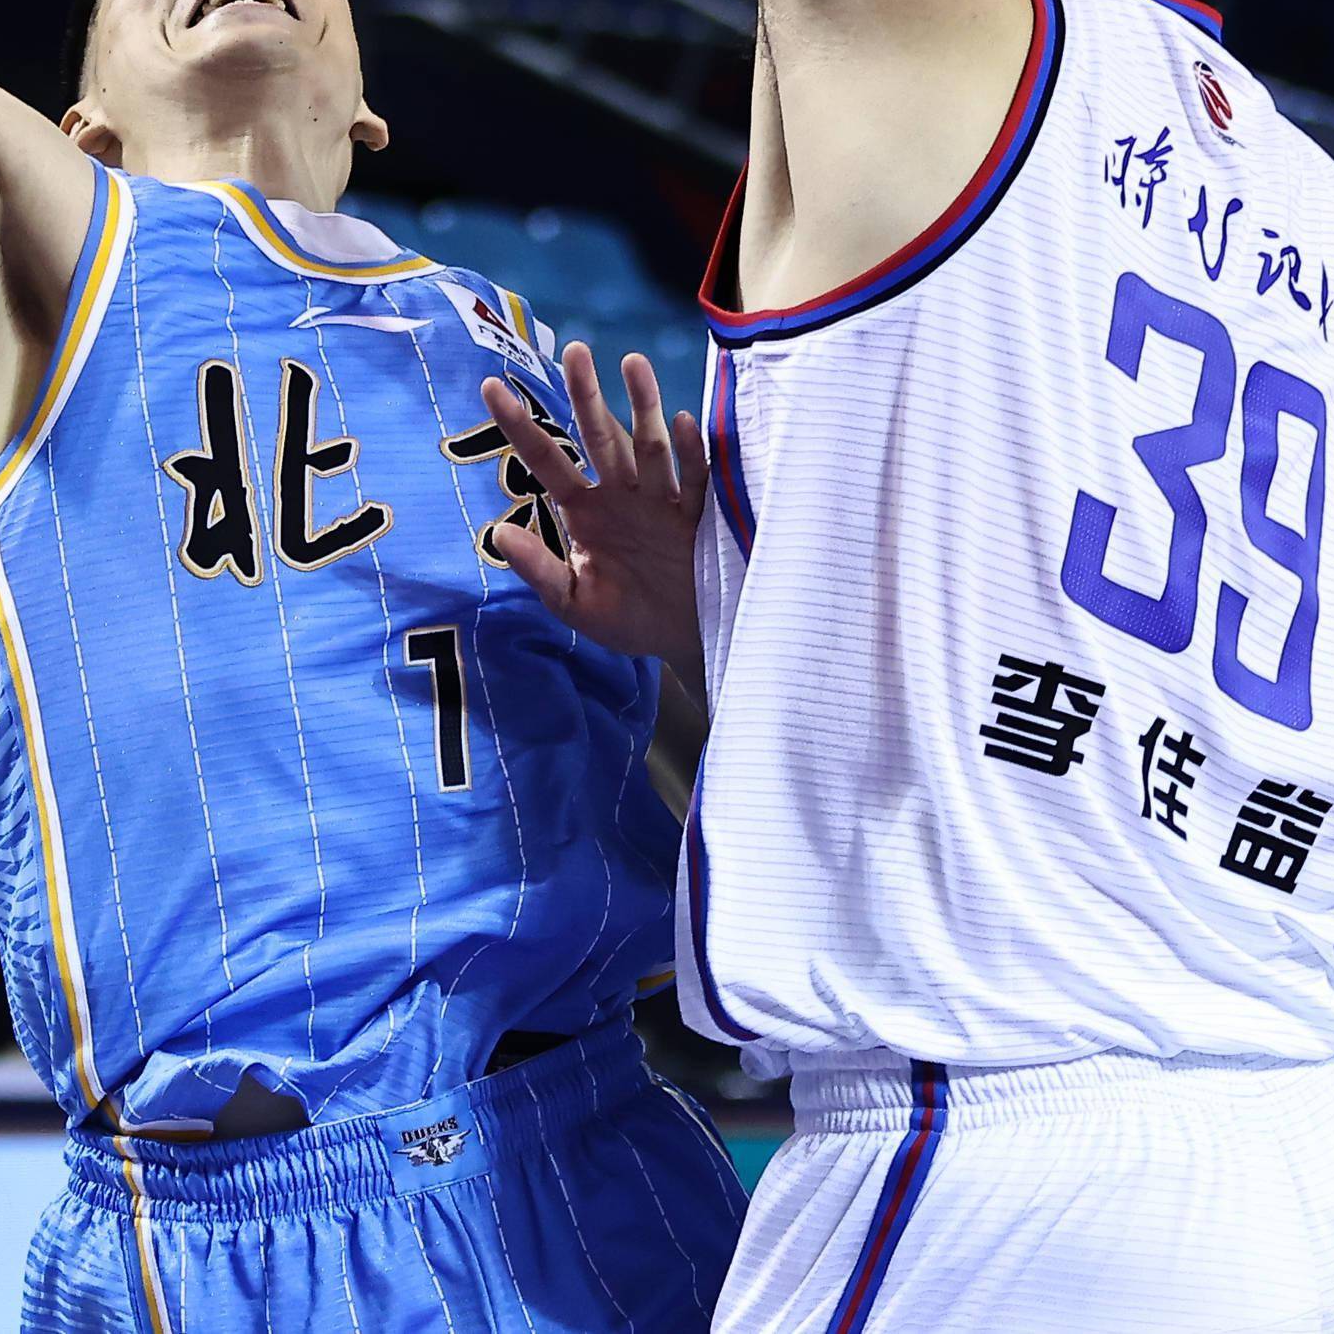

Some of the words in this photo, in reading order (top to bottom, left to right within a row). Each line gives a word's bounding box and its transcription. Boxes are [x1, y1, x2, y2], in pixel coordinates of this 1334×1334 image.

[1060, 271, 1327, 732] 39
[403, 624, 472, 792] 1
[979, 653, 1334, 894] 李佳益
[400, 1114, 459, 1145] DUCKS
